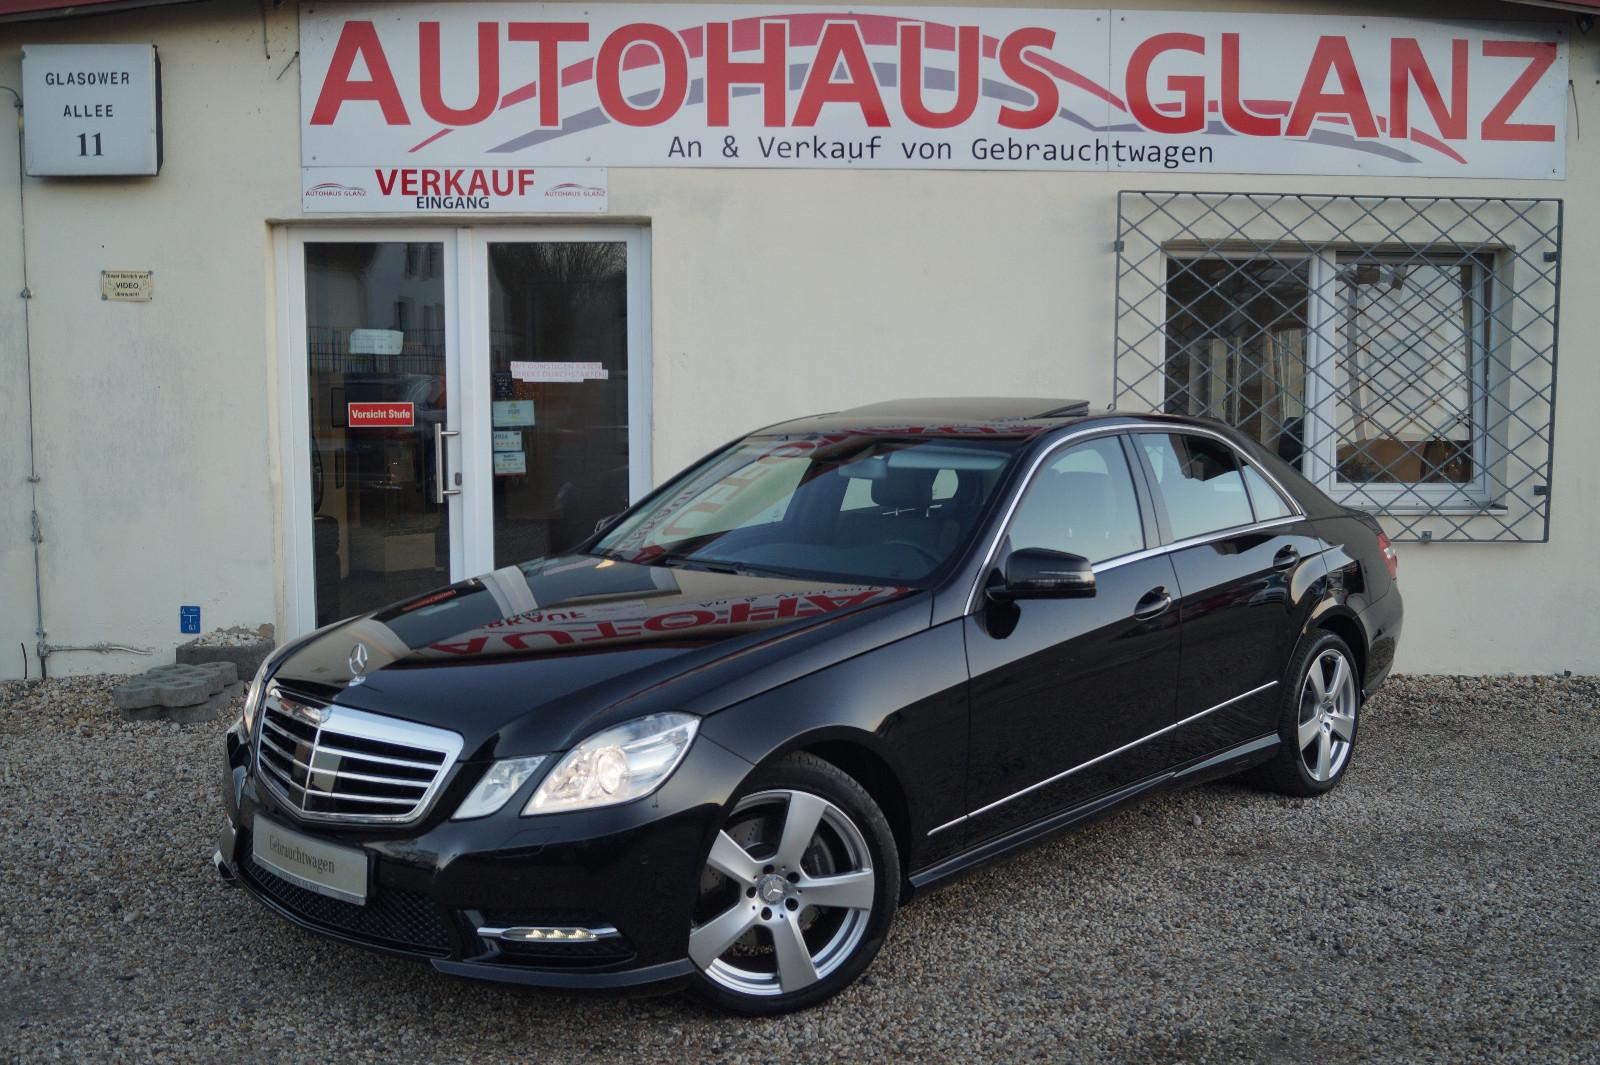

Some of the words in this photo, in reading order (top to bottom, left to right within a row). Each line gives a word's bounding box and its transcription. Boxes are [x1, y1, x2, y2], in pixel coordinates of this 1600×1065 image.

[45, 72, 130, 86] GLASOWER
[310, 21, 1059, 130] AUTOHAUS
[1125, 33, 1557, 142] GLANZ
[63, 104, 114, 118] ALLEE
[76, 132, 104, 157] 11
[668, 136, 703, 157] An
[722, 137, 740, 158] &
[758, 135, 882, 160] Verkauf
[902, 143, 952, 161] von
[971, 138, 1214, 168] Gebrauchtwagen
[375, 169, 535, 197] VERKAUF
[416, 196, 490, 209] EINGANG
[116, 282, 139, 290] VIDEO
[352, 409, 387, 419] Vorsicht
[388, 409, 411, 419] Stufe
[269, 834, 335, 874] Gebrauchtwagen
